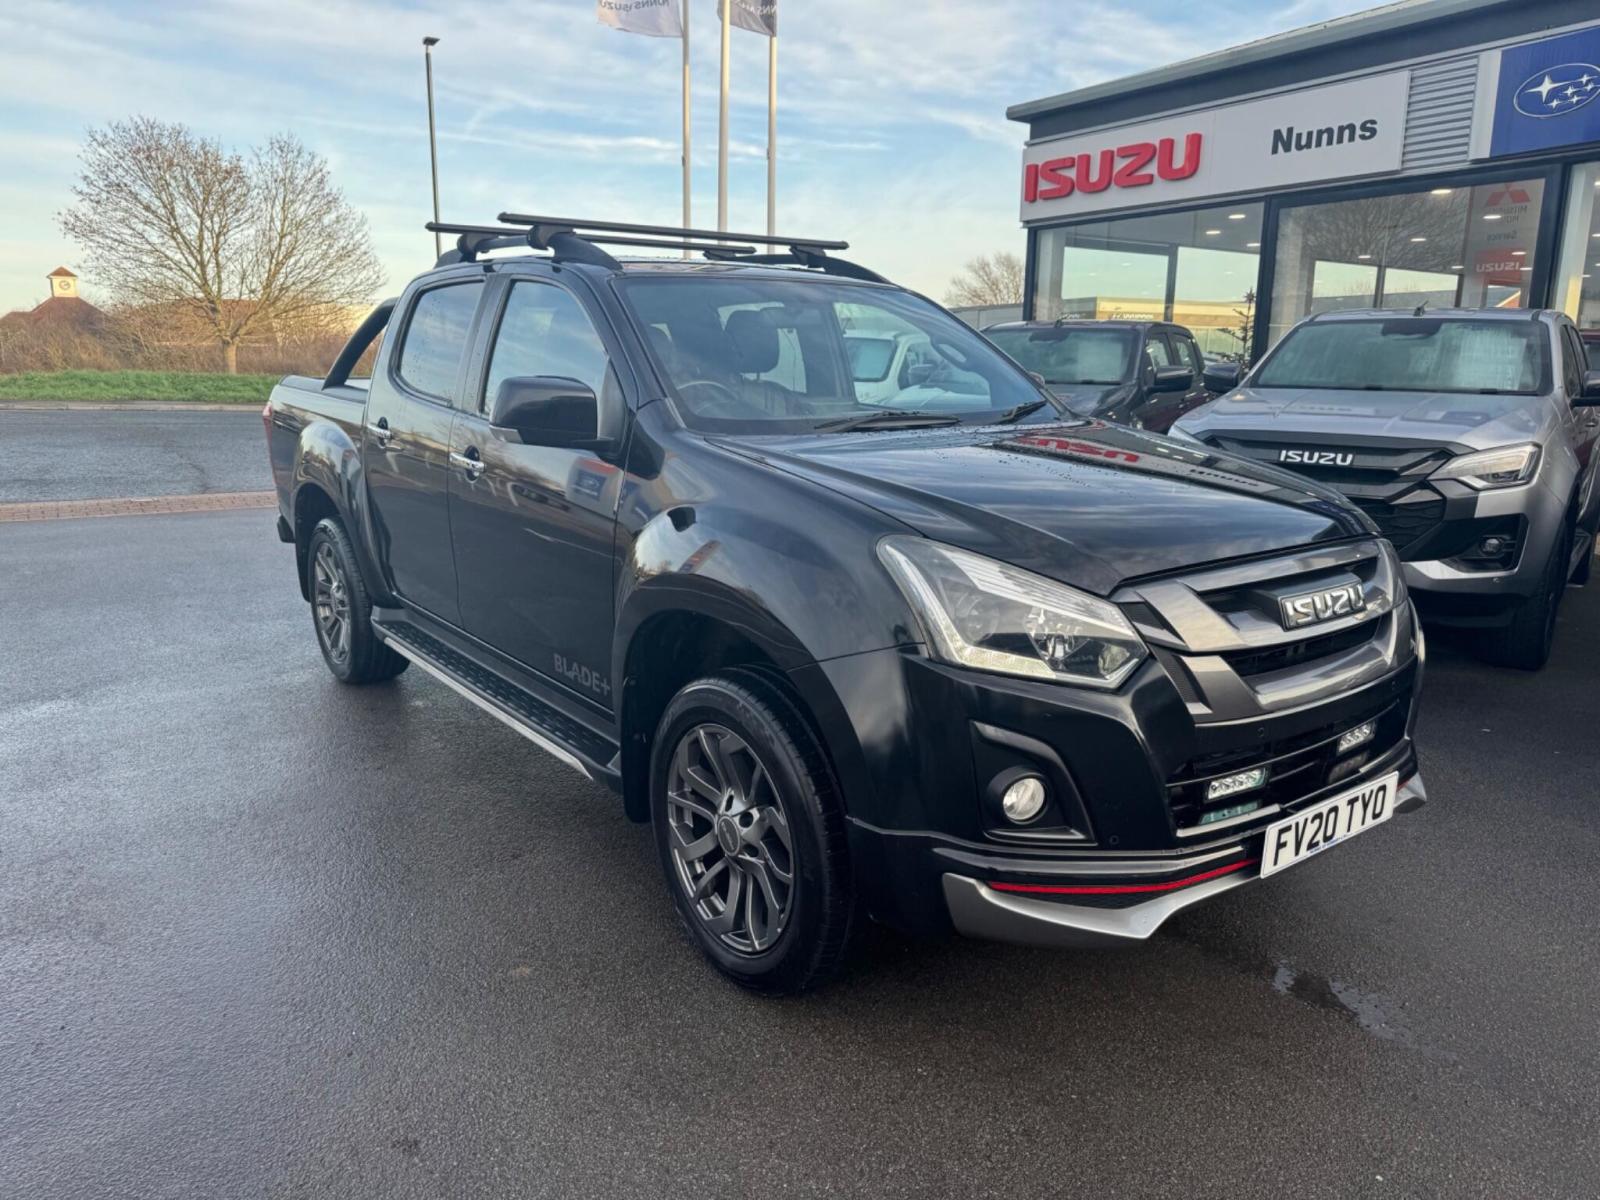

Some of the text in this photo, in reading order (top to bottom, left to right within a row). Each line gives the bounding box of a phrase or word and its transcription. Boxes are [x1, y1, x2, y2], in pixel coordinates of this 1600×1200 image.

[1024, 119, 1378, 203] ISUZU Nunns
[1280, 449, 1354, 466] ISUZU
[1284, 584, 1364, 626] ISUZU
[553, 653, 611, 696] BLADE+
[1273, 784, 1386, 866] FV20 TYO
